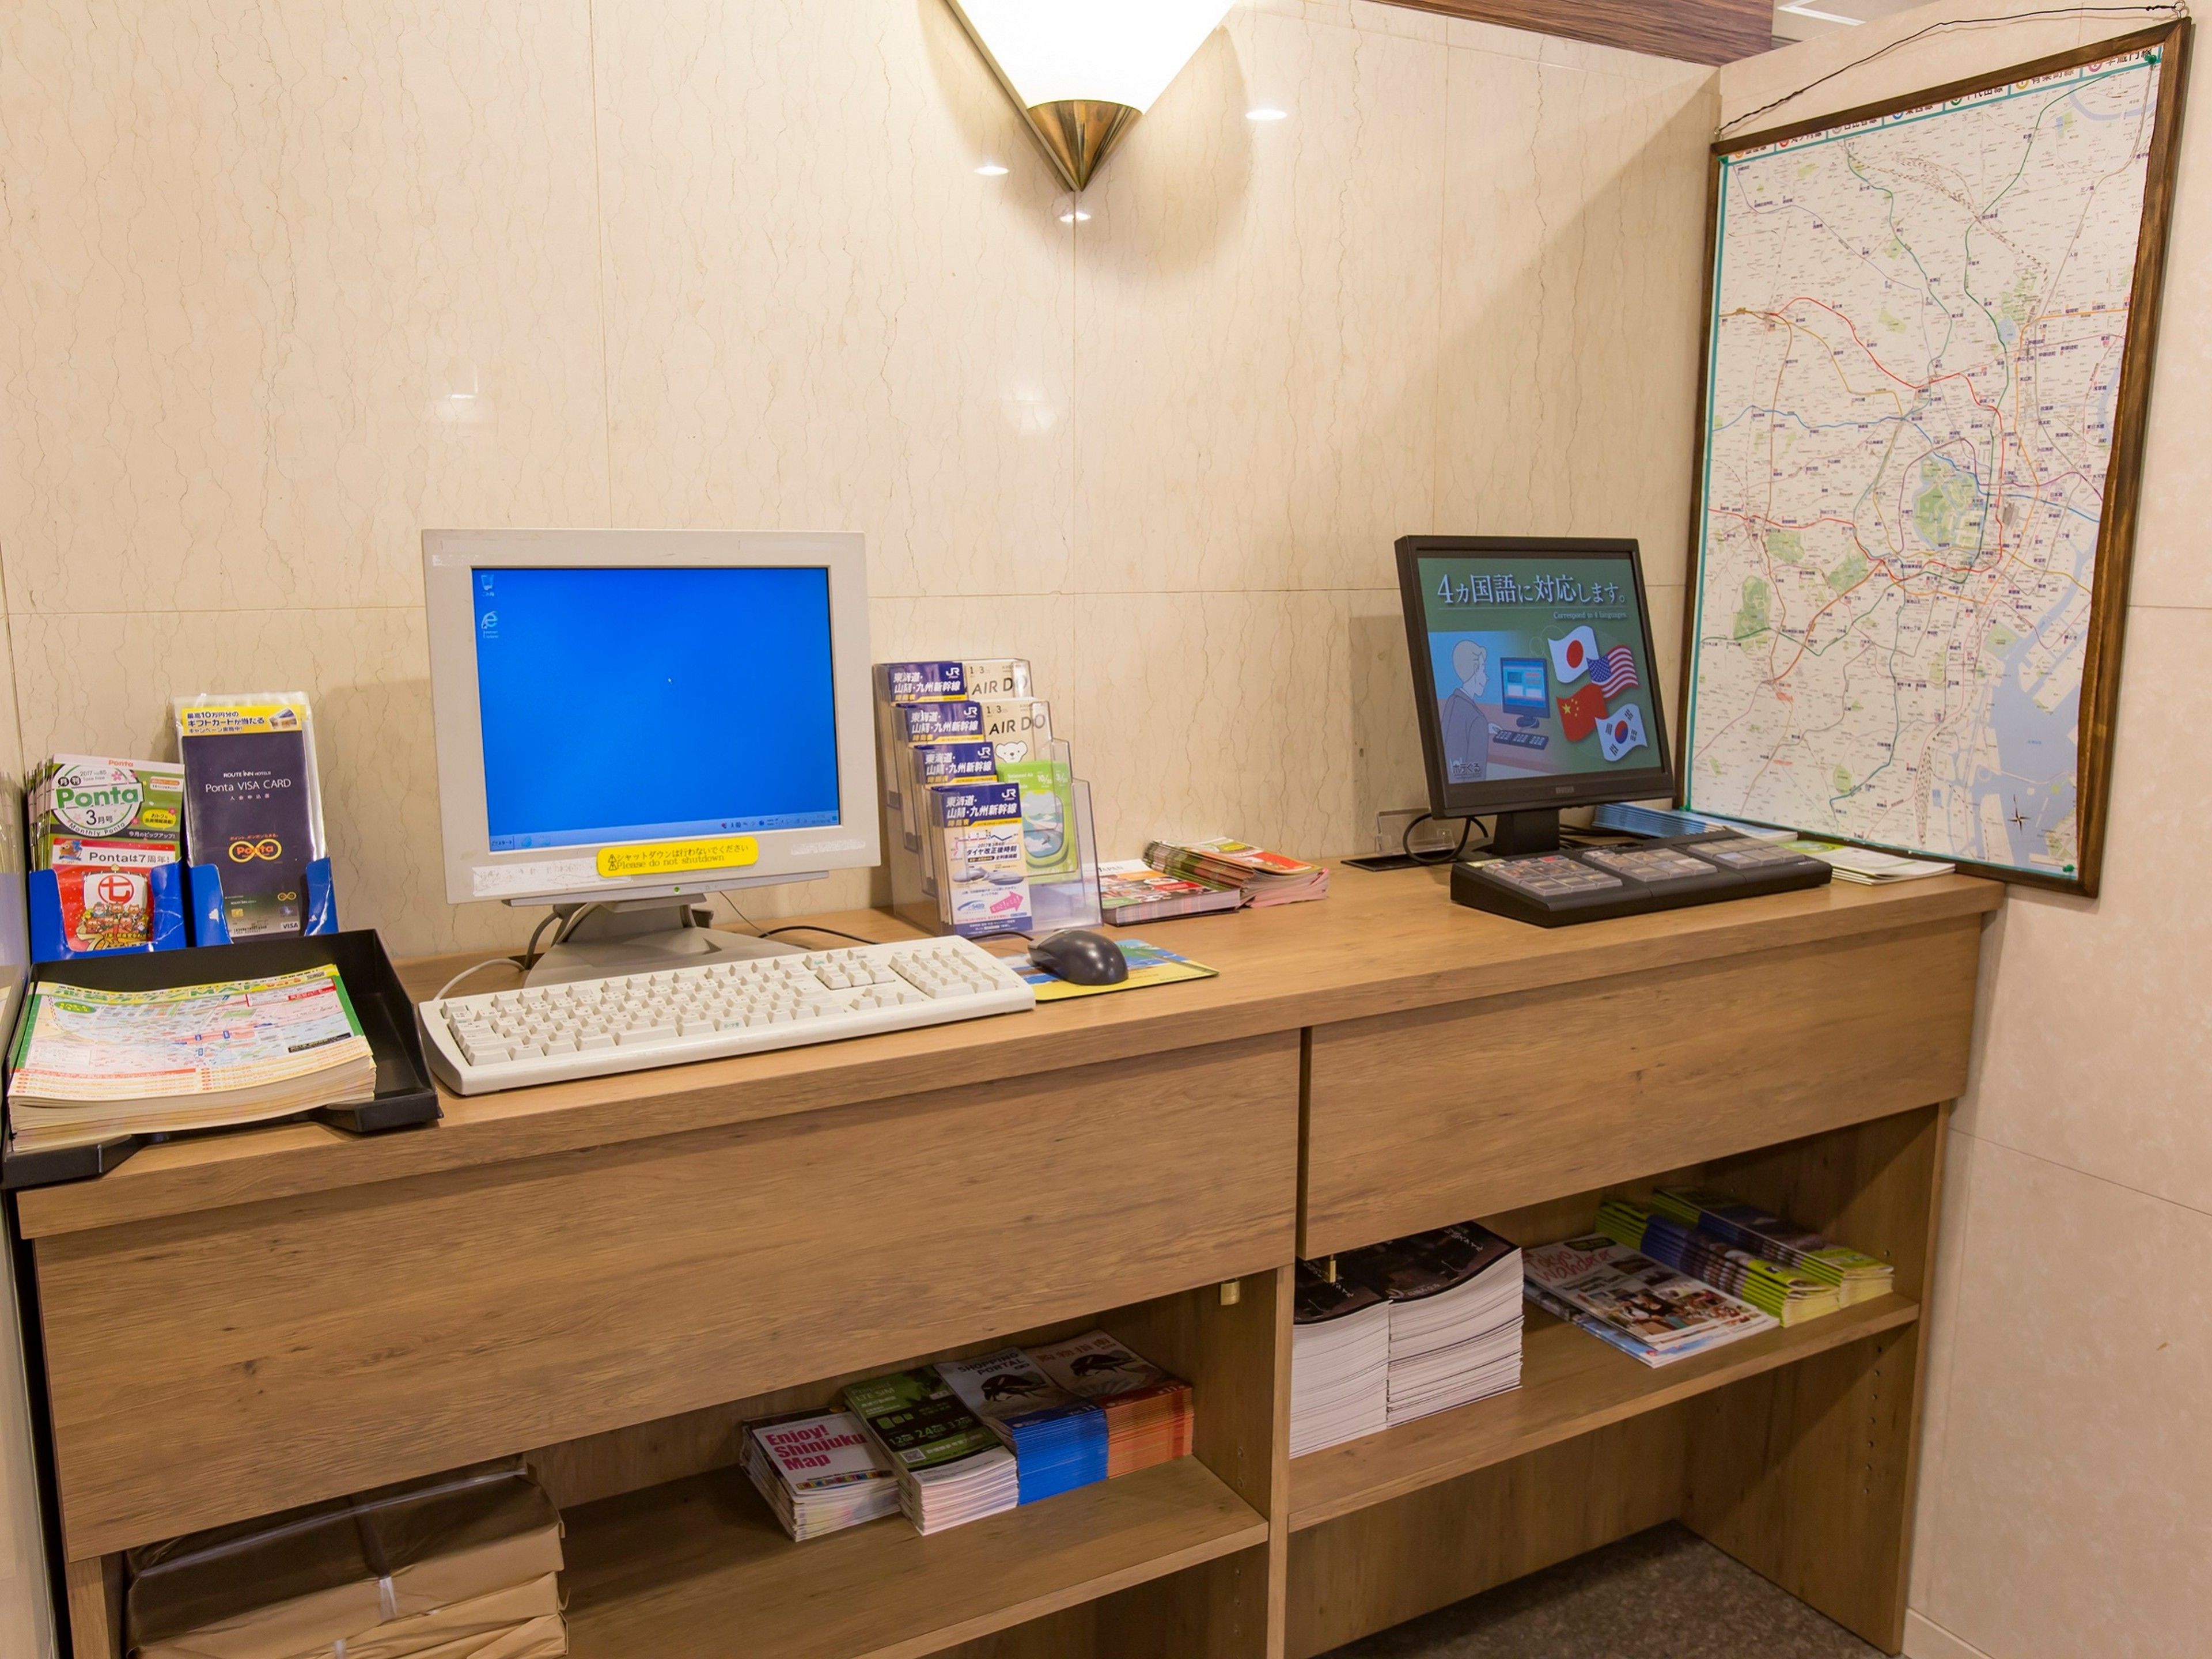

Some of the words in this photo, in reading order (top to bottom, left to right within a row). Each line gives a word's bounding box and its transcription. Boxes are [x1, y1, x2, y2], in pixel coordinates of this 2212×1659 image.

[1553, 611, 1585, 619] Correspond
[945, 667, 960, 676] JR
[972, 680, 998, 695] AIR
[964, 707, 978, 715] JR
[188, 718, 265, 728] ギフトカードが当たる
[988, 719, 1016, 735] AIR
[1021, 714, 1046, 731] DO
[977, 747, 991, 756] JR
[206, 784, 234, 793] Ponta
[237, 781, 260, 790] VISA
[263, 779, 291, 789] CARD
[1001, 789, 1016, 798] JR
[56, 786, 139, 809] Ponta
[86, 809, 113, 825] 3月号
[69, 823, 101, 836] Monthly
[104, 823, 126, 834] Ponta
[89, 852, 170, 863] Pontaは7周年!
[617, 843, 749, 862] シャットダウンは行わないでください
[617, 860, 646, 870] Please
[664, 858, 678, 866] not
[681, 854, 725, 864] shutdown
[957, 1353, 1019, 1373] SHOPPING
[978, 1358, 1025, 1376] PORTAL
[876, 1387, 895, 1397] SIM
[765, 1425, 830, 1446] Enjoy!
[774, 1433, 868, 1458] Shinjuku
[782, 1453, 831, 1471] Map
